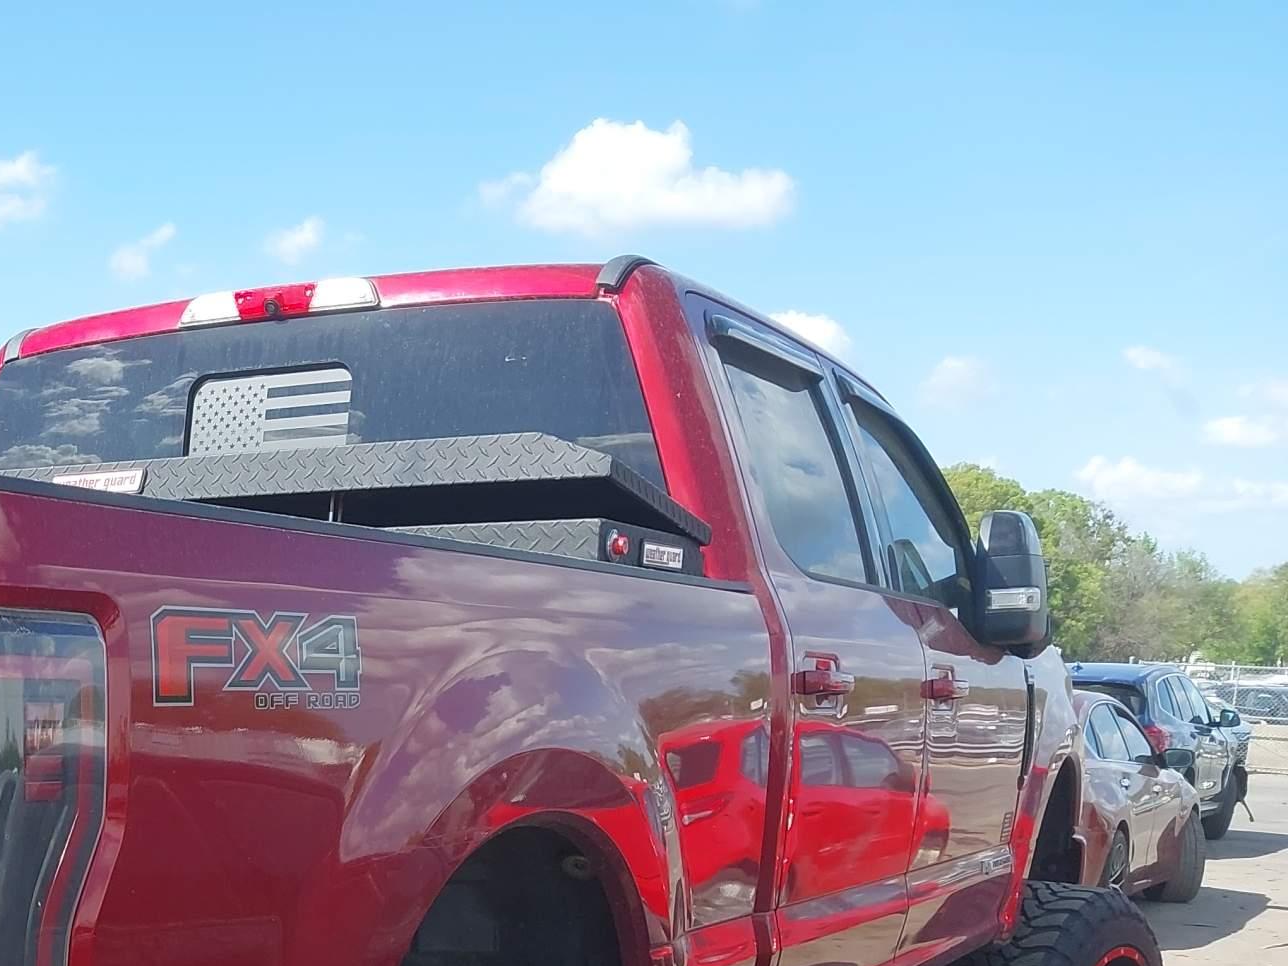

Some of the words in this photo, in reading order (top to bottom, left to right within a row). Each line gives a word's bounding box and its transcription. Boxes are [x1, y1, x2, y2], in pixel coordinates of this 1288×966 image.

[103, 472, 137, 491] guard
[150, 605, 361, 707] FX4
[254, 692, 299, 710] OFF
[305, 692, 361, 710] ROAD
